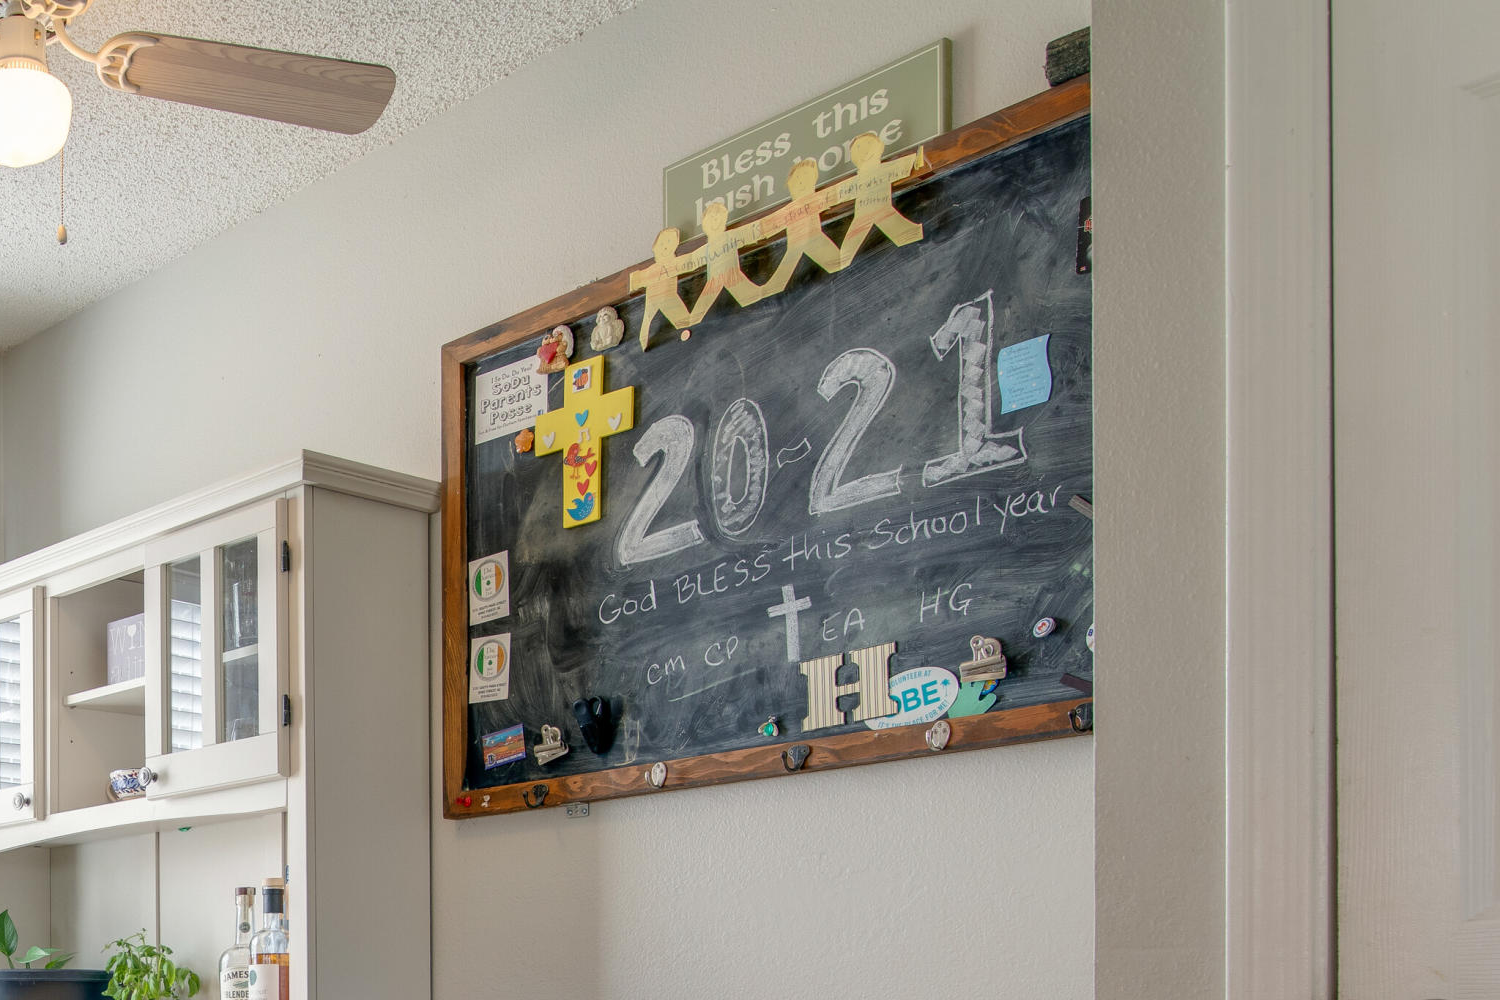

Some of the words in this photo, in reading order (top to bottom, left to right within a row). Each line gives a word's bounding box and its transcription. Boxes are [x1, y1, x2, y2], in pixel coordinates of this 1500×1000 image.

[701, 132, 792, 189] Bless
[812, 88, 889, 138] this
[695, 174, 775, 227] Iish
[793, 119, 903, 172] oe
[481, 384, 542, 415] Parents
[492, 375, 531, 395] SoDu
[490, 404, 533, 425] Posse
[598, 579, 658, 625] God
[673, 553, 771, 605] BLESS
[782, 530, 852, 571] this
[868, 495, 981, 550] School
[994, 484, 1063, 535] year
[822, 608, 866, 641] EA
[919, 583, 973, 623] HG
[925, 710, 938, 721] FOR
